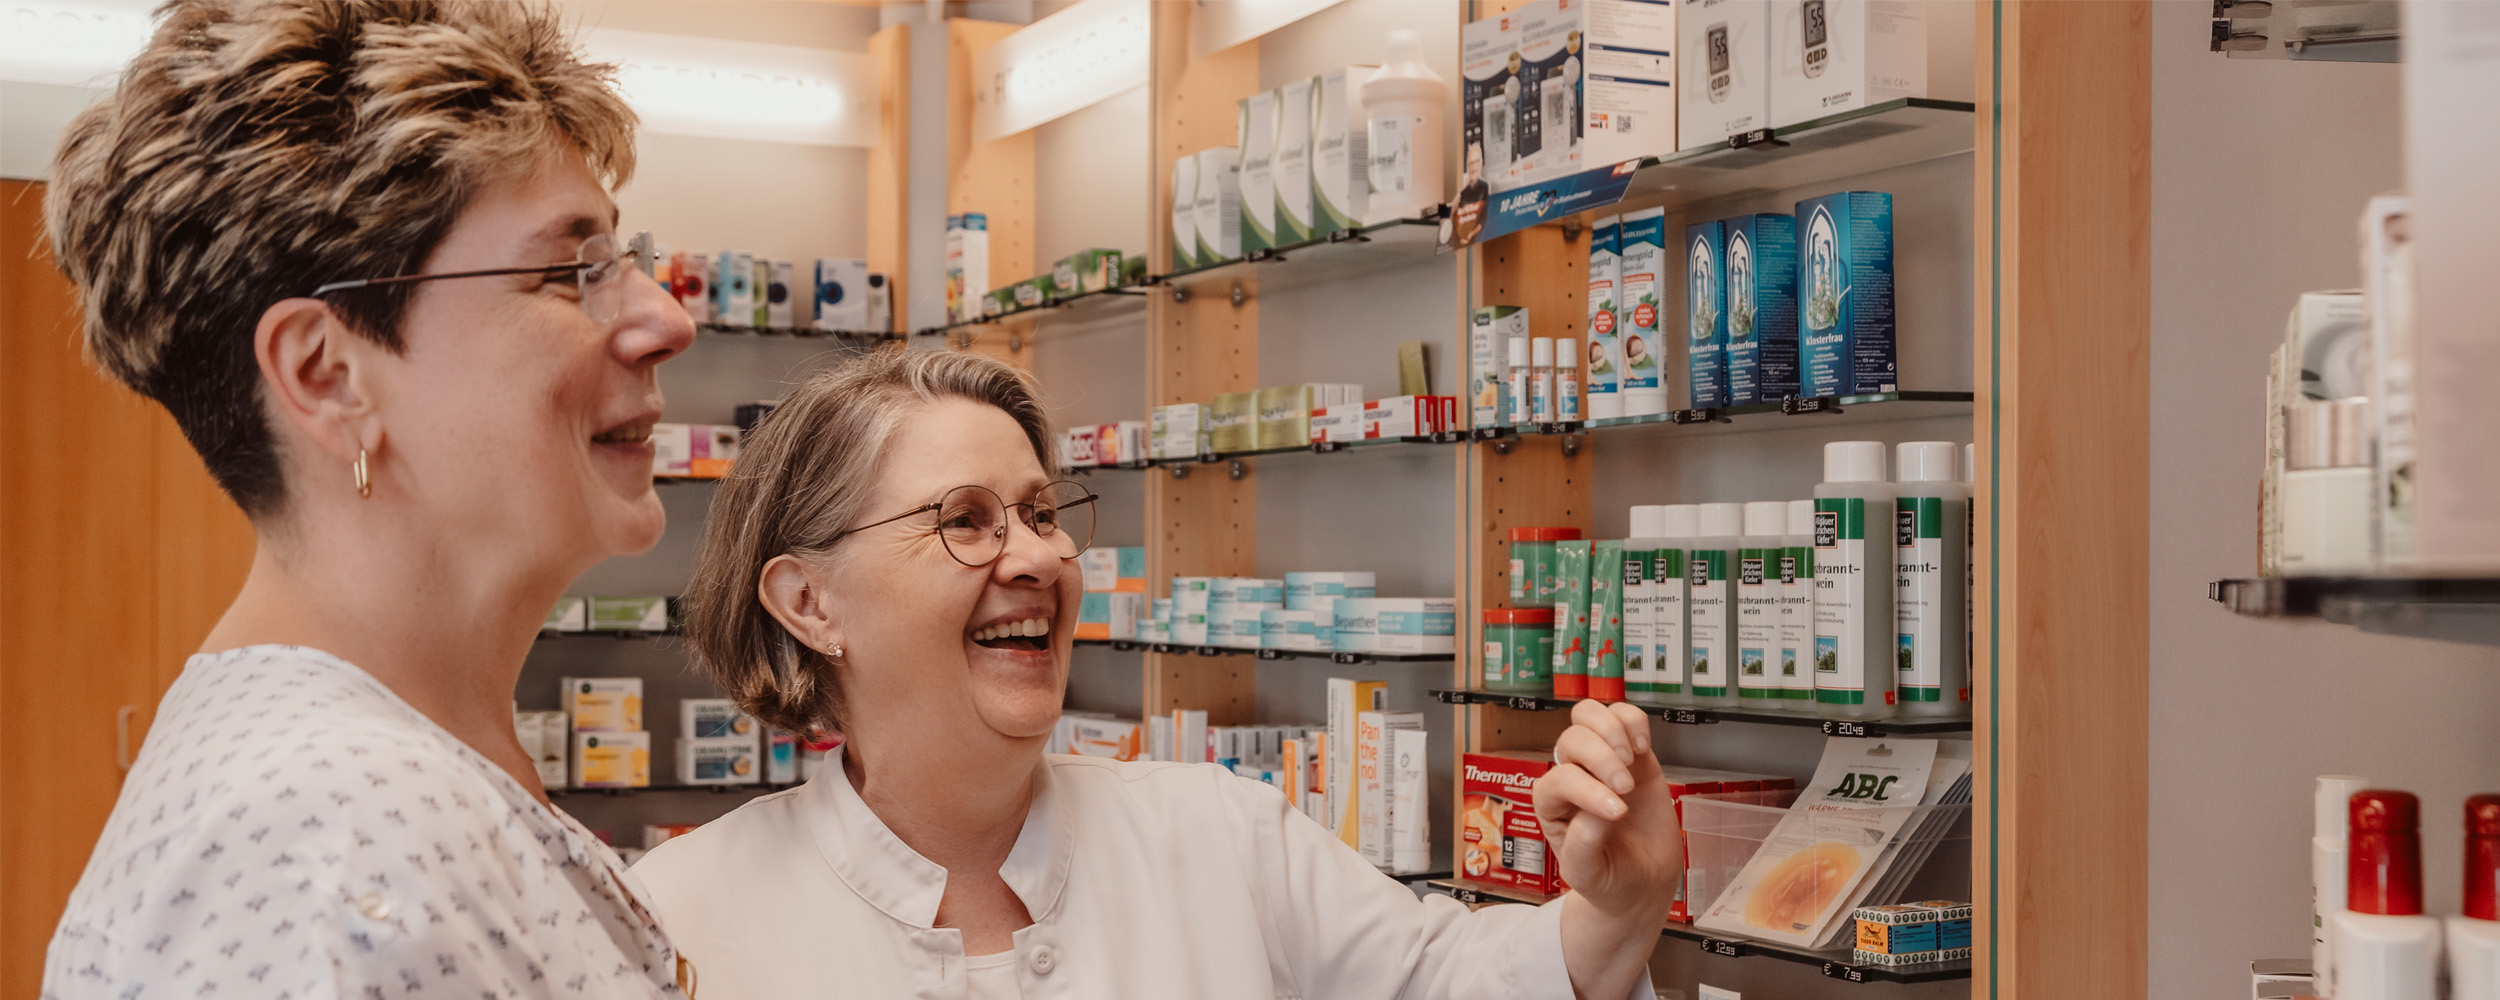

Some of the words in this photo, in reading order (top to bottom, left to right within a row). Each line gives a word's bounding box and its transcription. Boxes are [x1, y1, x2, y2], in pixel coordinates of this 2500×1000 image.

[1500, 198, 1510, 213] 10
[1509, 189, 1541, 212] JAHRE
[1726, 340, 1758, 352] Klosterfrau
[1806, 332, 1843, 347] Klosterfrau
[1689, 343, 1720, 354] Klosterfrau
[1782, 400, 1791, 413] €
[1674, 410, 1681, 422] €
[1897, 562, 1938, 573] rannt-
[1509, 697, 1515, 708] €
[1664, 709, 1671, 721] €
[1361, 721, 1380, 741] Pan
[1823, 721, 1832, 734] €
[1838, 722, 1864, 736] 20.49
[1361, 743, 1378, 760] the
[1361, 763, 1377, 780] nol
[1465, 765, 1541, 788] ThermaCare
[1827, 772, 1899, 801] ABC
[1504, 840, 1513, 852] 12
[1516, 874, 1522, 884] 2
[1702, 939, 1710, 951] €
[1823, 963, 1832, 975] €
[1843, 966, 1861, 982] 7.99
